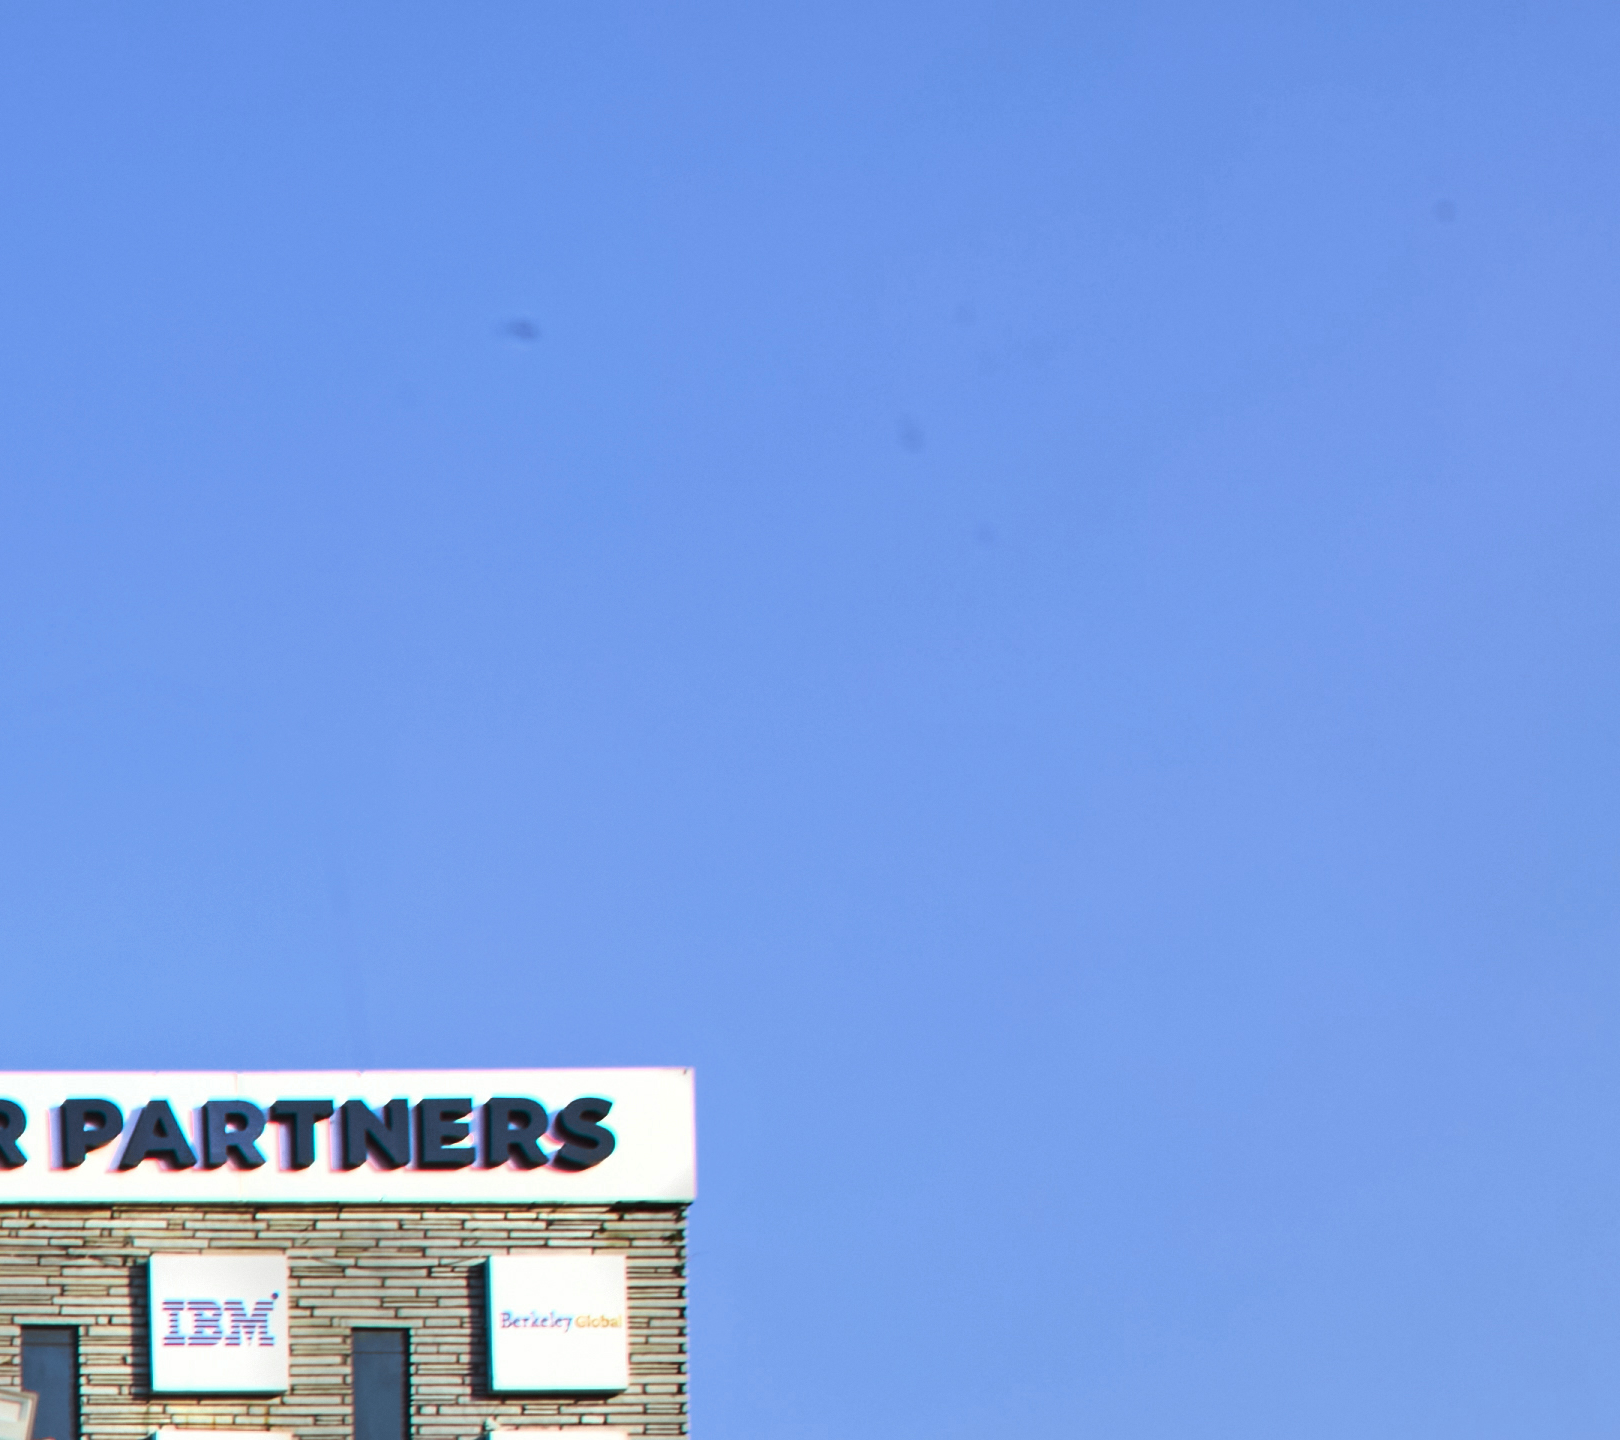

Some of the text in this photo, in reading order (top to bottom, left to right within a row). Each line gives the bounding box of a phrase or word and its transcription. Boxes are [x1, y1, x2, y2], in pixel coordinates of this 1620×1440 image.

[54, 1097, 616, 1171] PARTNERS
[162, 1301, 275, 1346] IBM
[500, 1310, 622, 1333] Berkeley Global
